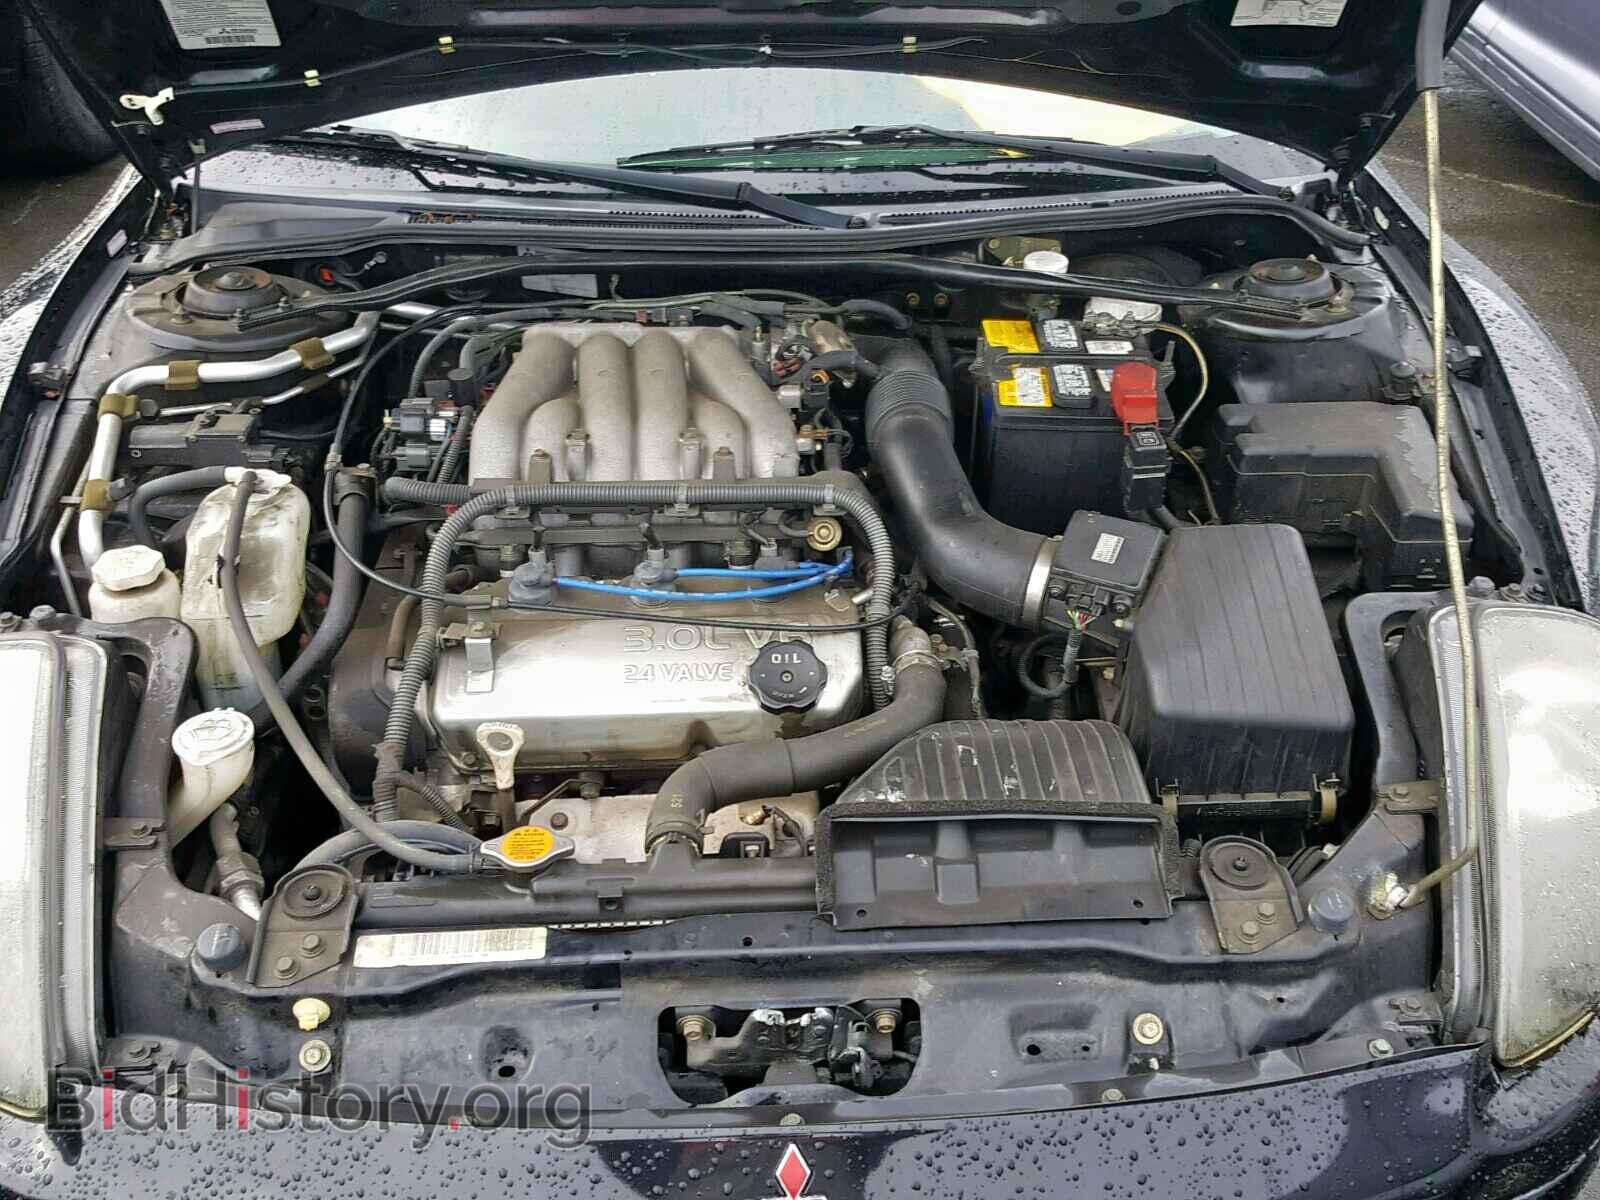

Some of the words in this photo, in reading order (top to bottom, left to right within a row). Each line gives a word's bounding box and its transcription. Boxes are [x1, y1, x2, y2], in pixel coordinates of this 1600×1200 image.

[624, 623, 730, 651] 3.0L
[771, 653, 802, 664] OIL
[624, 664, 655, 682] 24
[660, 662, 733, 681] VALVE
